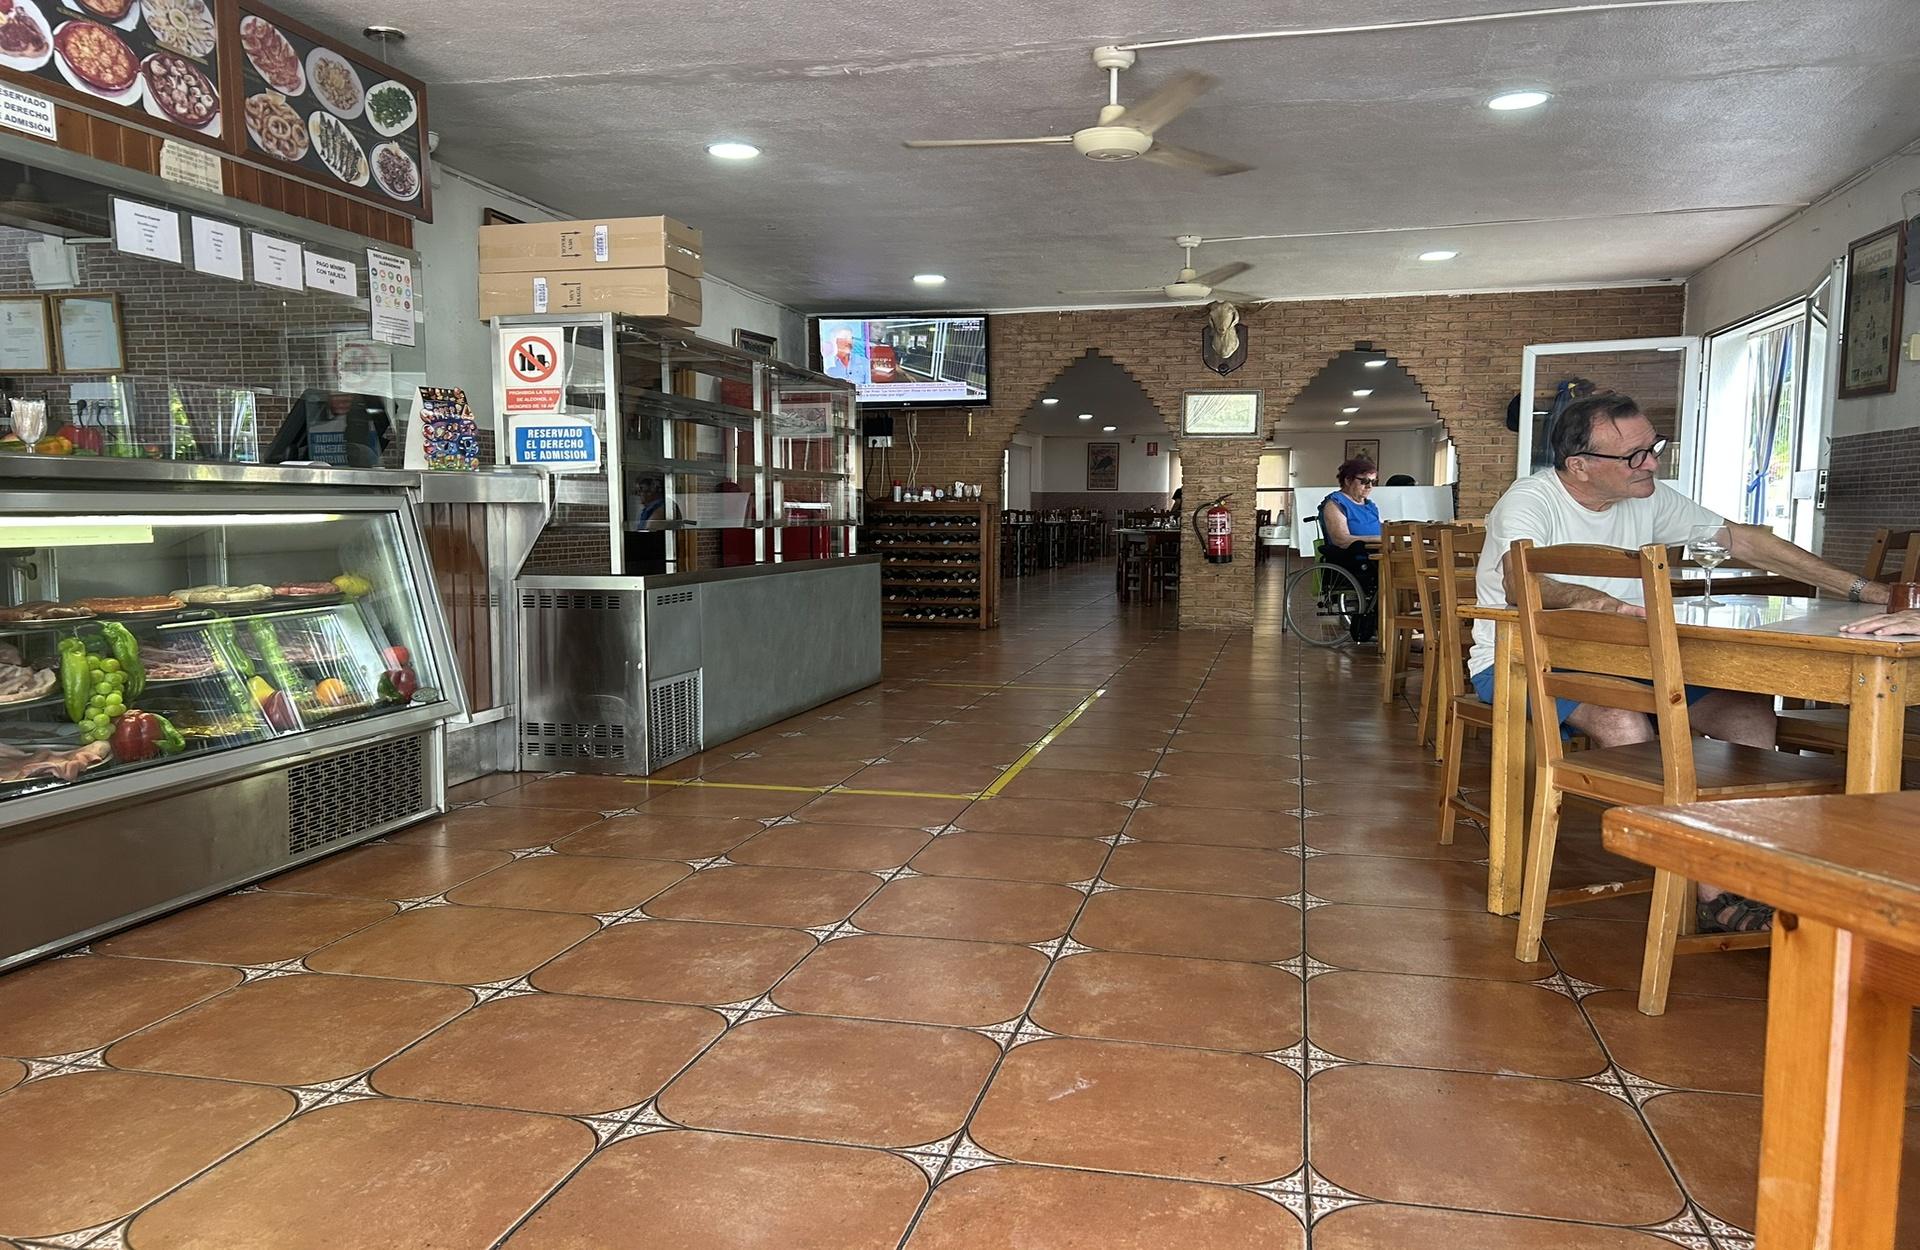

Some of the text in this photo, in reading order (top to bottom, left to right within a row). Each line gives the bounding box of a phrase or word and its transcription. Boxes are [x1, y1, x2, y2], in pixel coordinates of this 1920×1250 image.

[4, 101, 49, 121] DERECHO
[315, 260, 329, 269] PAGO
[316, 267, 347, 280] CON TARJETA
[527, 428, 583, 438] RESERVADO
[526, 439, 584, 449] EL DERECHO
[524, 450, 588, 460] DE ADMISION
